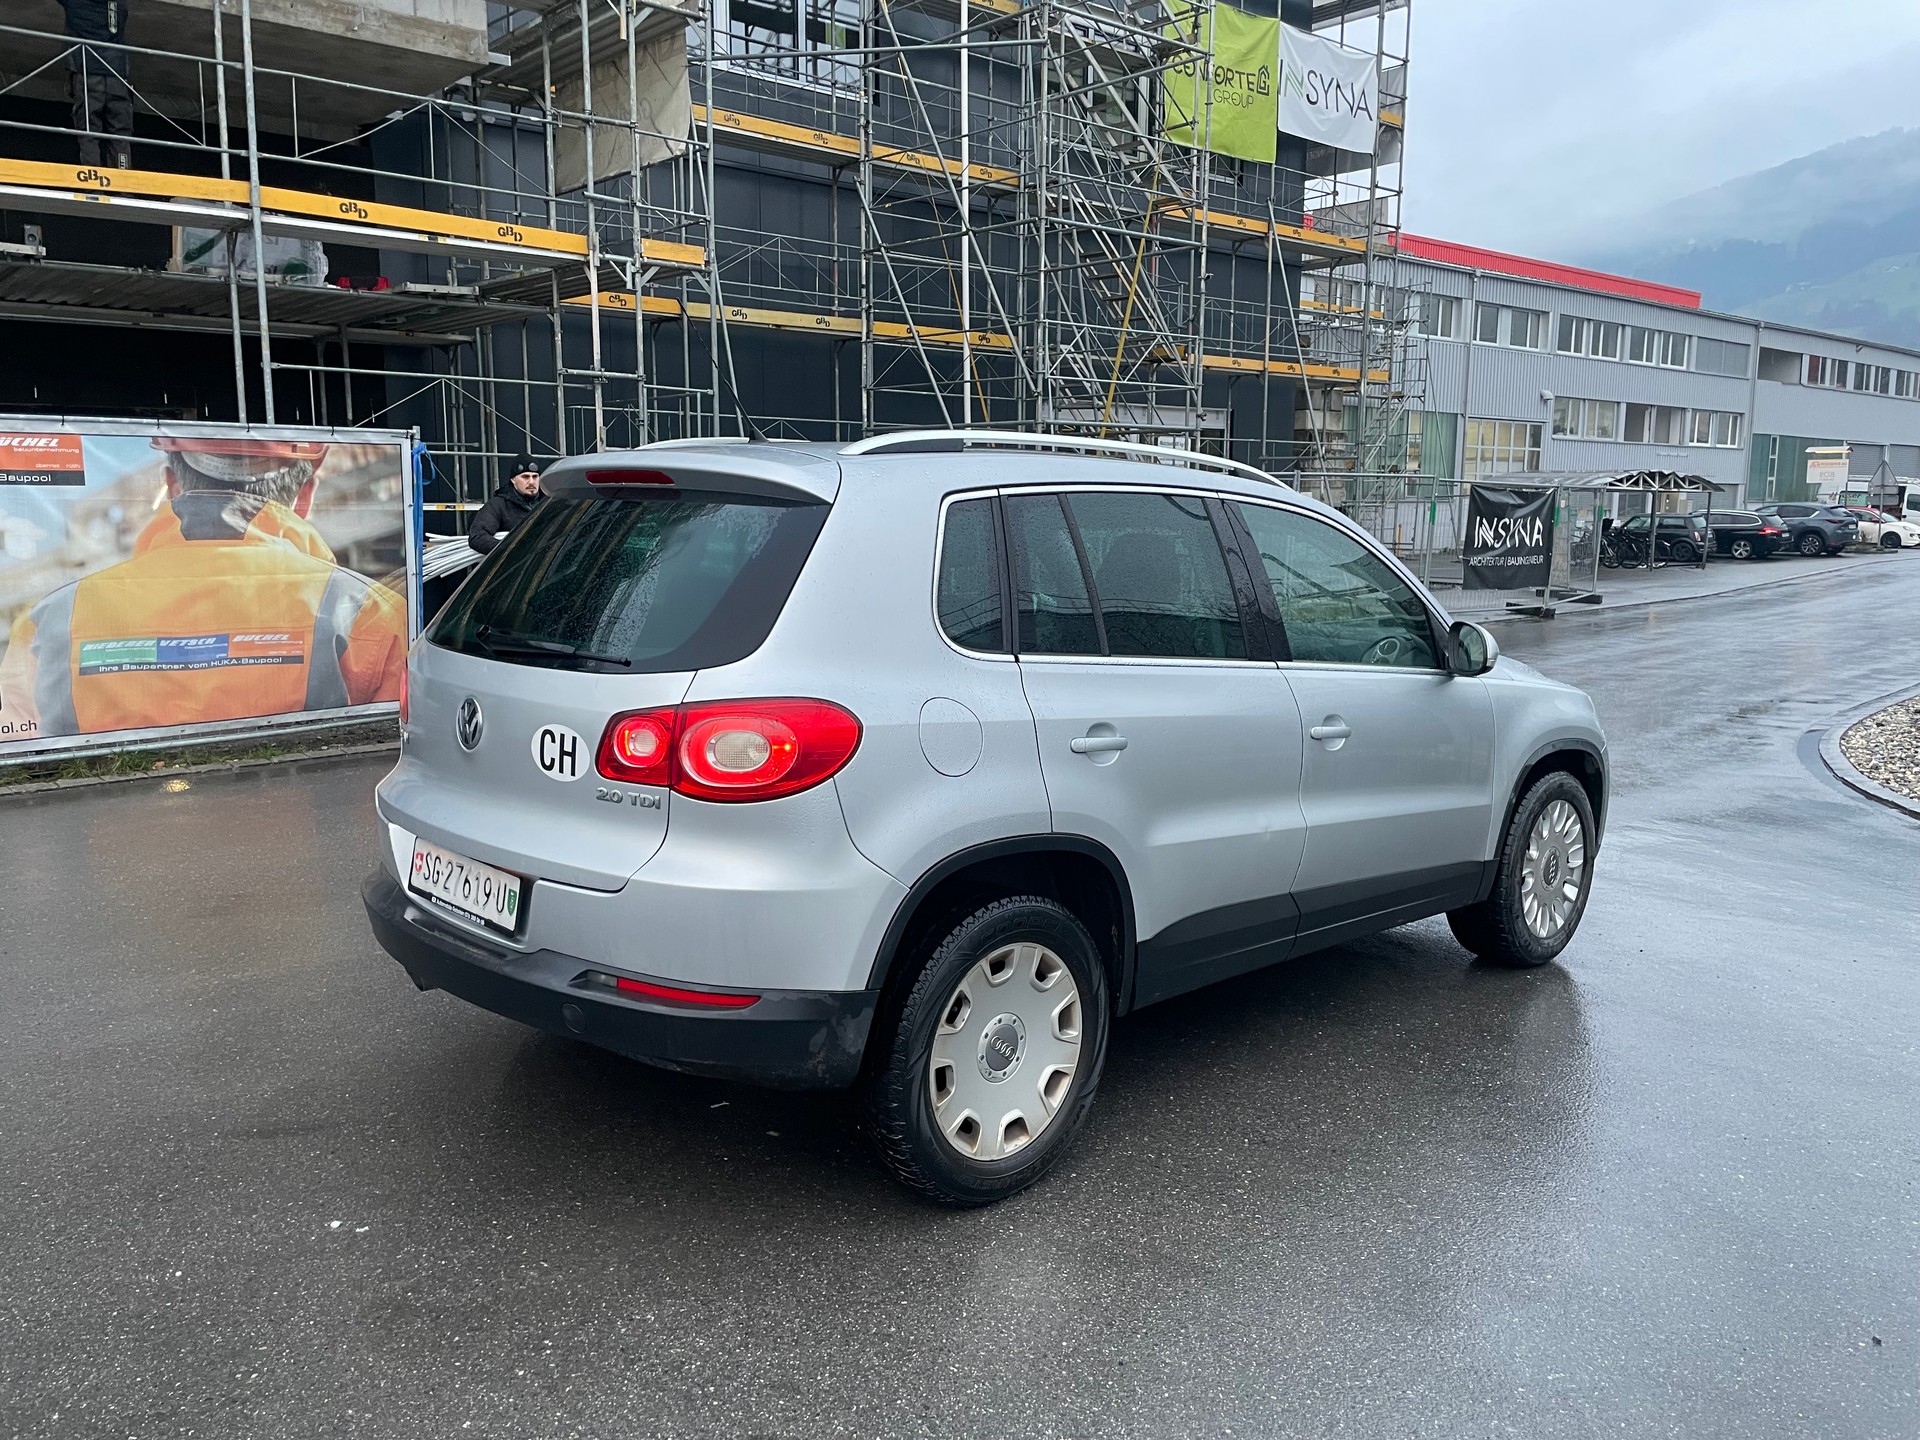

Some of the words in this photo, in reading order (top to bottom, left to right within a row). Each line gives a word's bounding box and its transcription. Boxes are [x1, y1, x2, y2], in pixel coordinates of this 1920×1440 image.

[1213, 88, 1254, 109] GROUP
[76, 169, 111, 187] GBD
[980, 168, 993, 178] GBD
[338, 201, 368, 219] GBD
[497, 225, 523, 242] GBD
[608, 294, 627, 306] GBD
[732, 309, 747, 320] GBD
[815, 317, 830, 327] GBD
[1474, 515, 1543, 548] INSYNA
[1469, 556, 1504, 567] ARCHITEKTUR
[99, 665, 119, 673] Ihre
[122, 662, 186, 671] Baupartner
[188, 661, 208, 669] vom
[210, 657, 282, 667] HUKA-Baupool
[539, 728, 578, 777] CH
[628, 791, 661, 810] TDI
